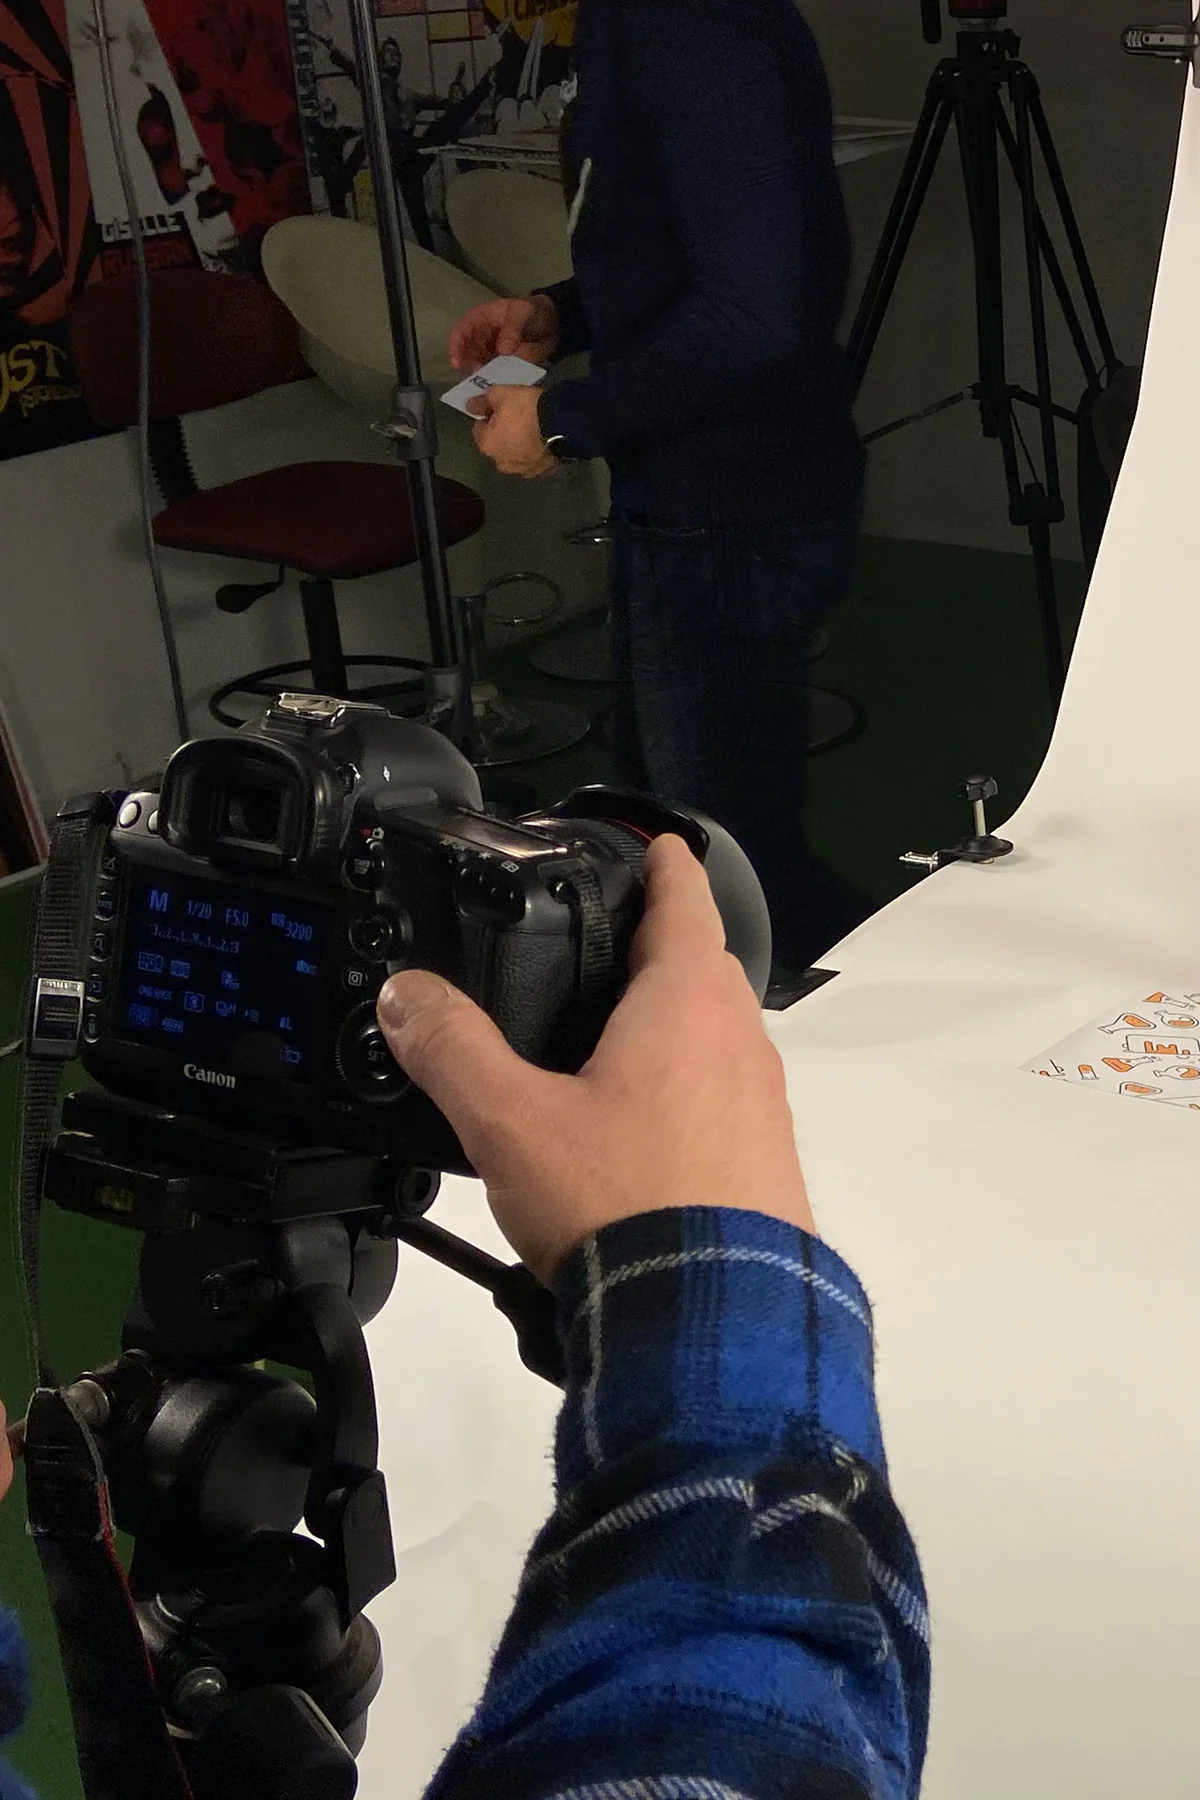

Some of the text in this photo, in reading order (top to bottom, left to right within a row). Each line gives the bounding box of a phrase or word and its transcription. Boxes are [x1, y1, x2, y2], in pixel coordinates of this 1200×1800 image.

[148, 889, 169, 912] M
[285, 920, 313, 941] 3200
[183, 1063, 236, 1089] Canon
